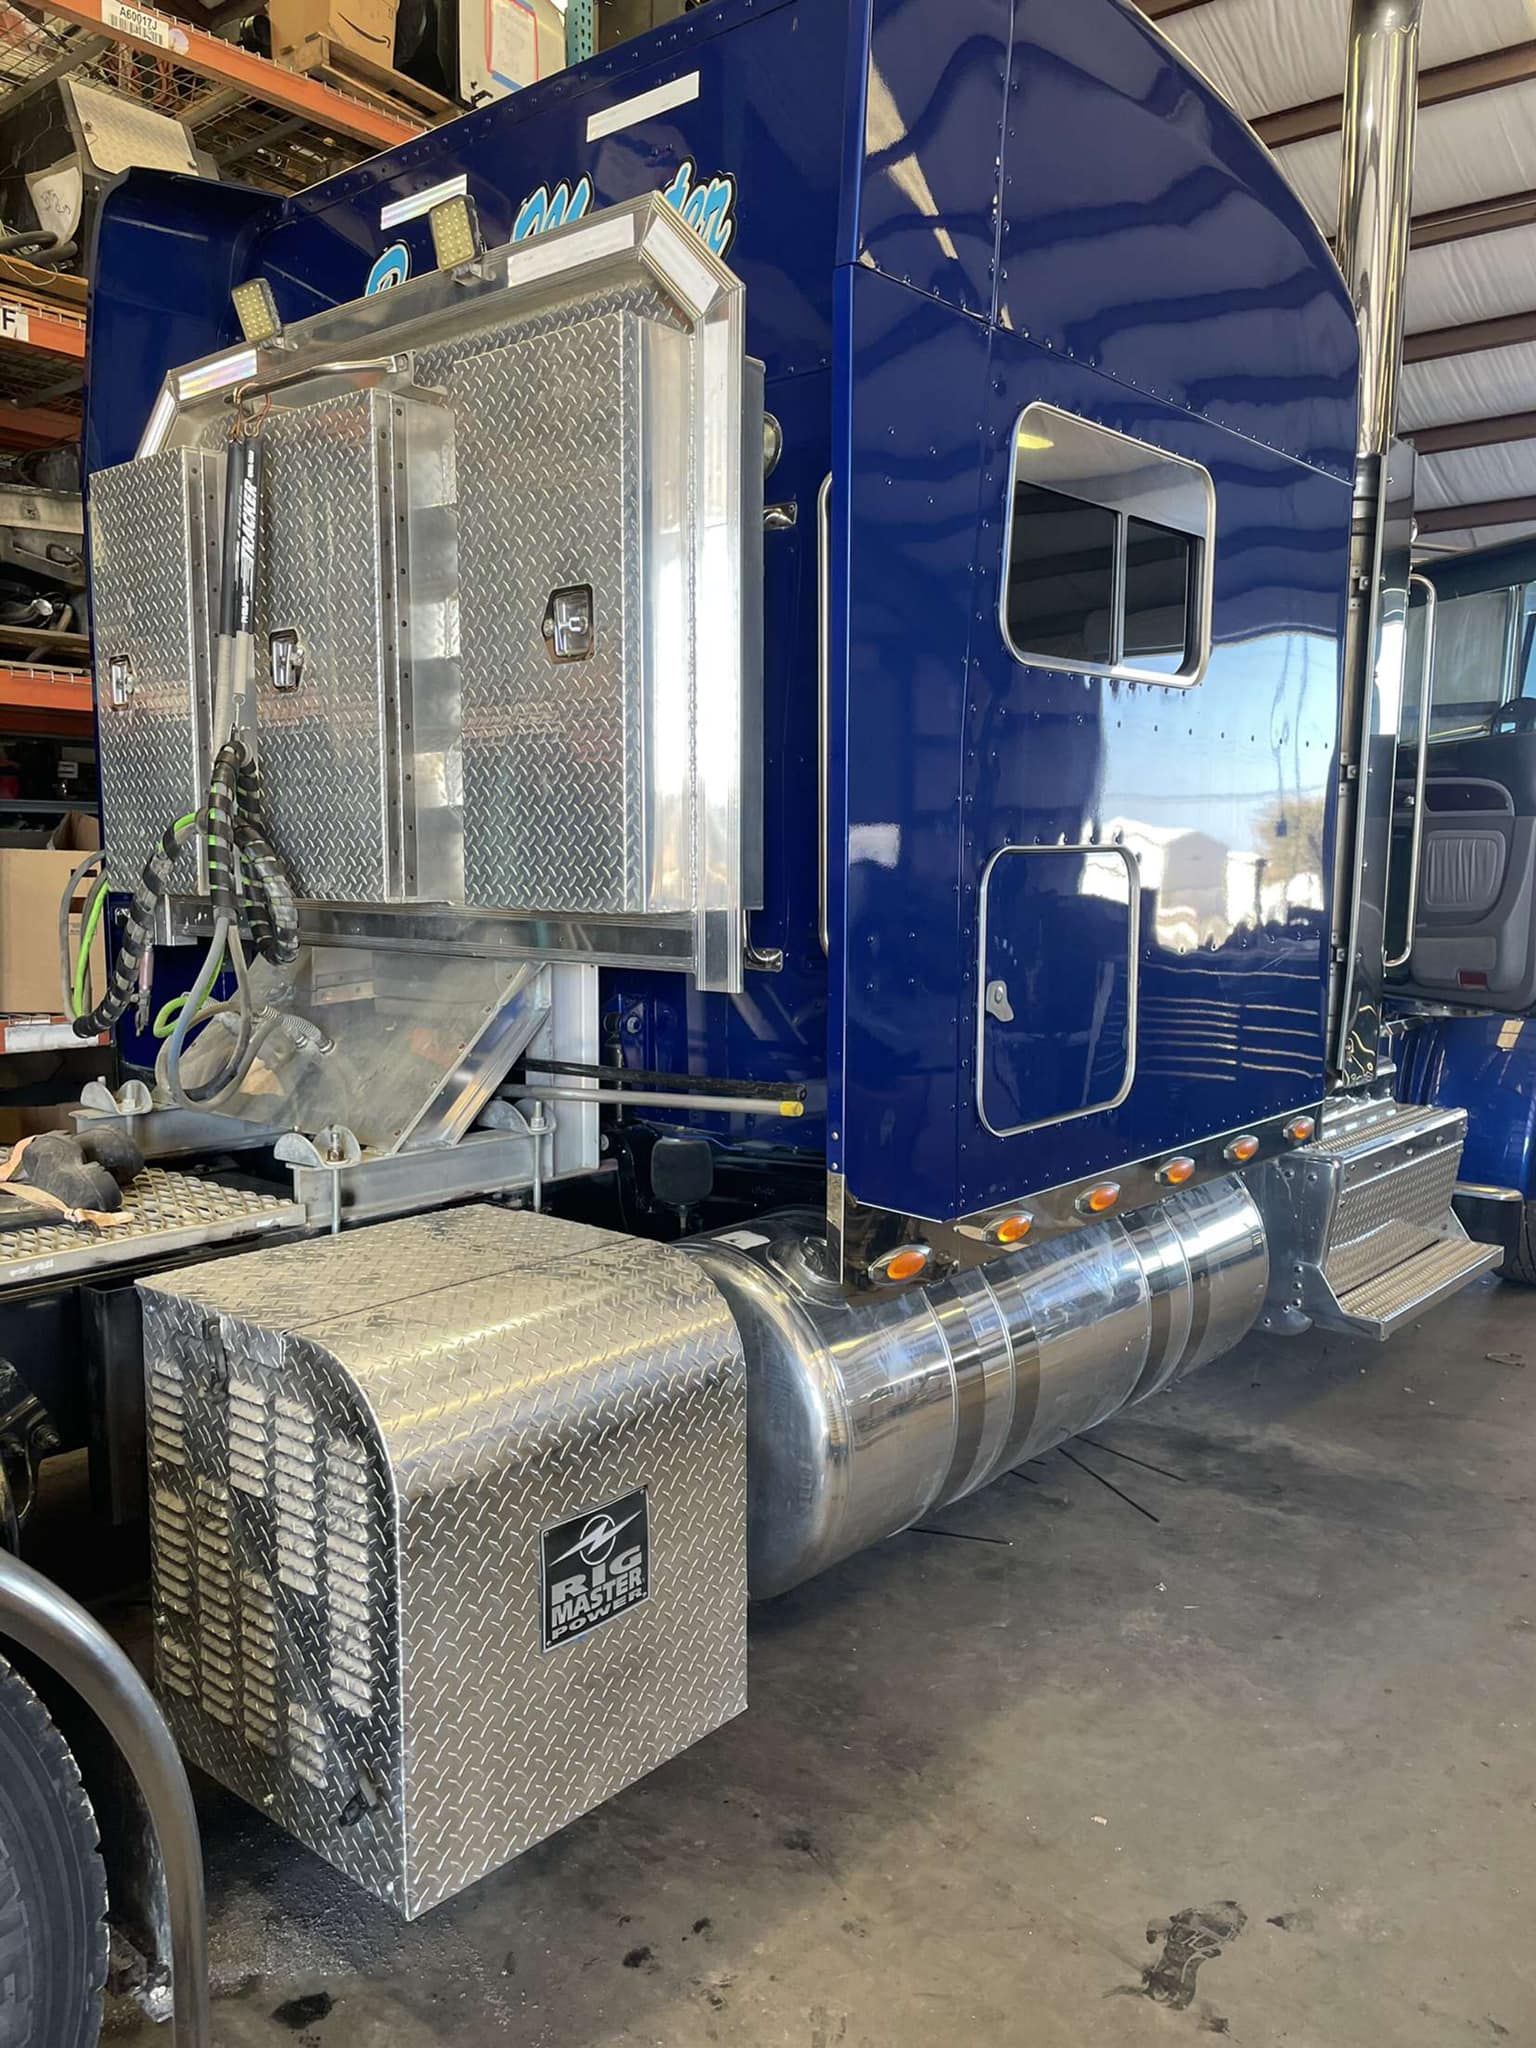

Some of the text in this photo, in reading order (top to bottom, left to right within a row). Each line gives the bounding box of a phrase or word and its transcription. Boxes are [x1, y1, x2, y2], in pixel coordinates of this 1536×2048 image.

[120, 6, 157, 31] A60017J
[241, 478, 258, 562] TRACKER
[551, 1544, 642, 1607] RIG
[551, 1566, 642, 1629] MASTER
[551, 1586, 642, 1641] POWER
